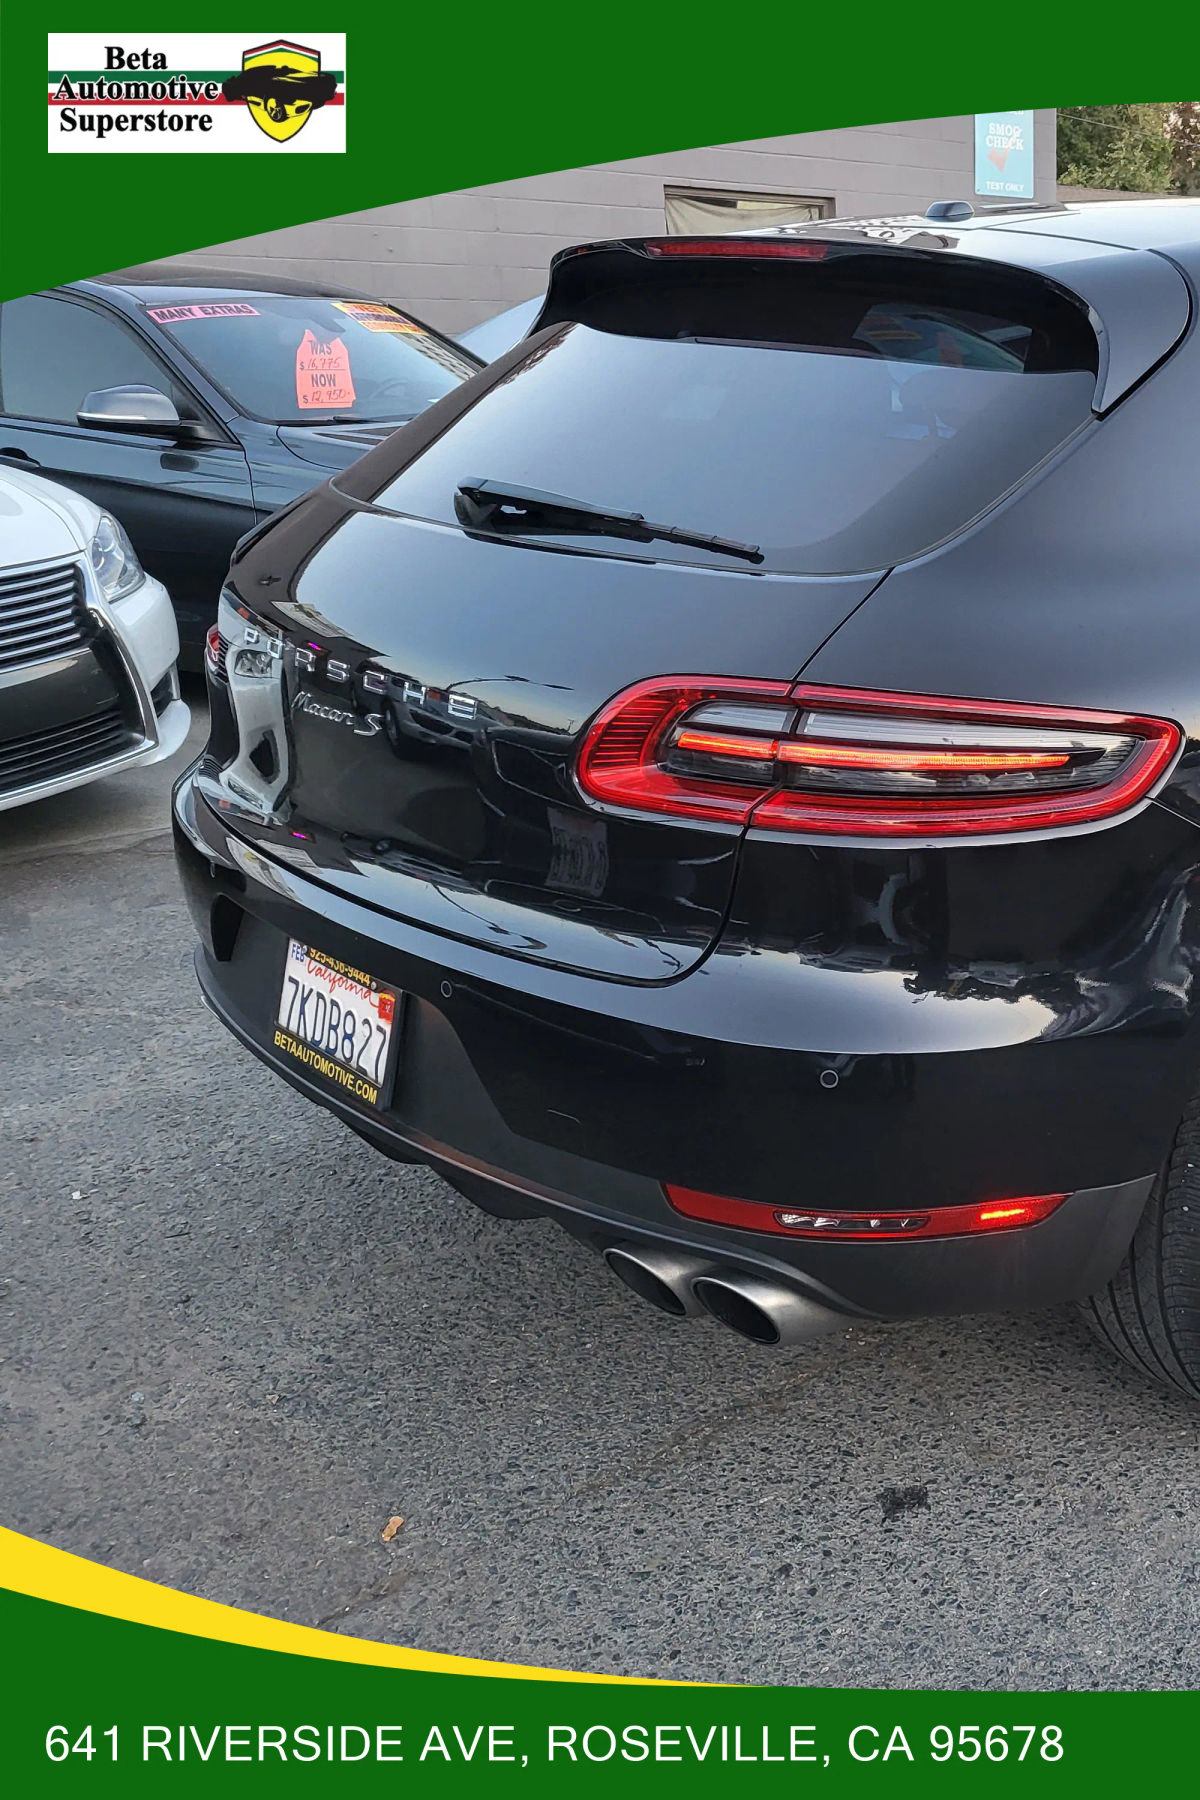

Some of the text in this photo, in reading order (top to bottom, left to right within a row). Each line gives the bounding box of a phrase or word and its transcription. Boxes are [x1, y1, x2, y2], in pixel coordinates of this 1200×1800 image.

[988, 123, 1022, 137] SMOG
[985, 136, 1024, 151] CHECK
[986, 181, 1025, 192] TEST ONLY
[154, 305, 255, 322] MANY EXTRAS
[308, 340, 332, 355] WAS
[311, 373, 336, 388] NOW
[244, 627, 478, 720] PORSCHE
[291, 692, 384, 736] Macan S
[290, 943, 305, 963] FEB
[306, 959, 379, 1008] California
[286, 975, 387, 1083] 7KDB827
[274, 1031, 378, 1105] BETAAUTOMOTIVE.COM
